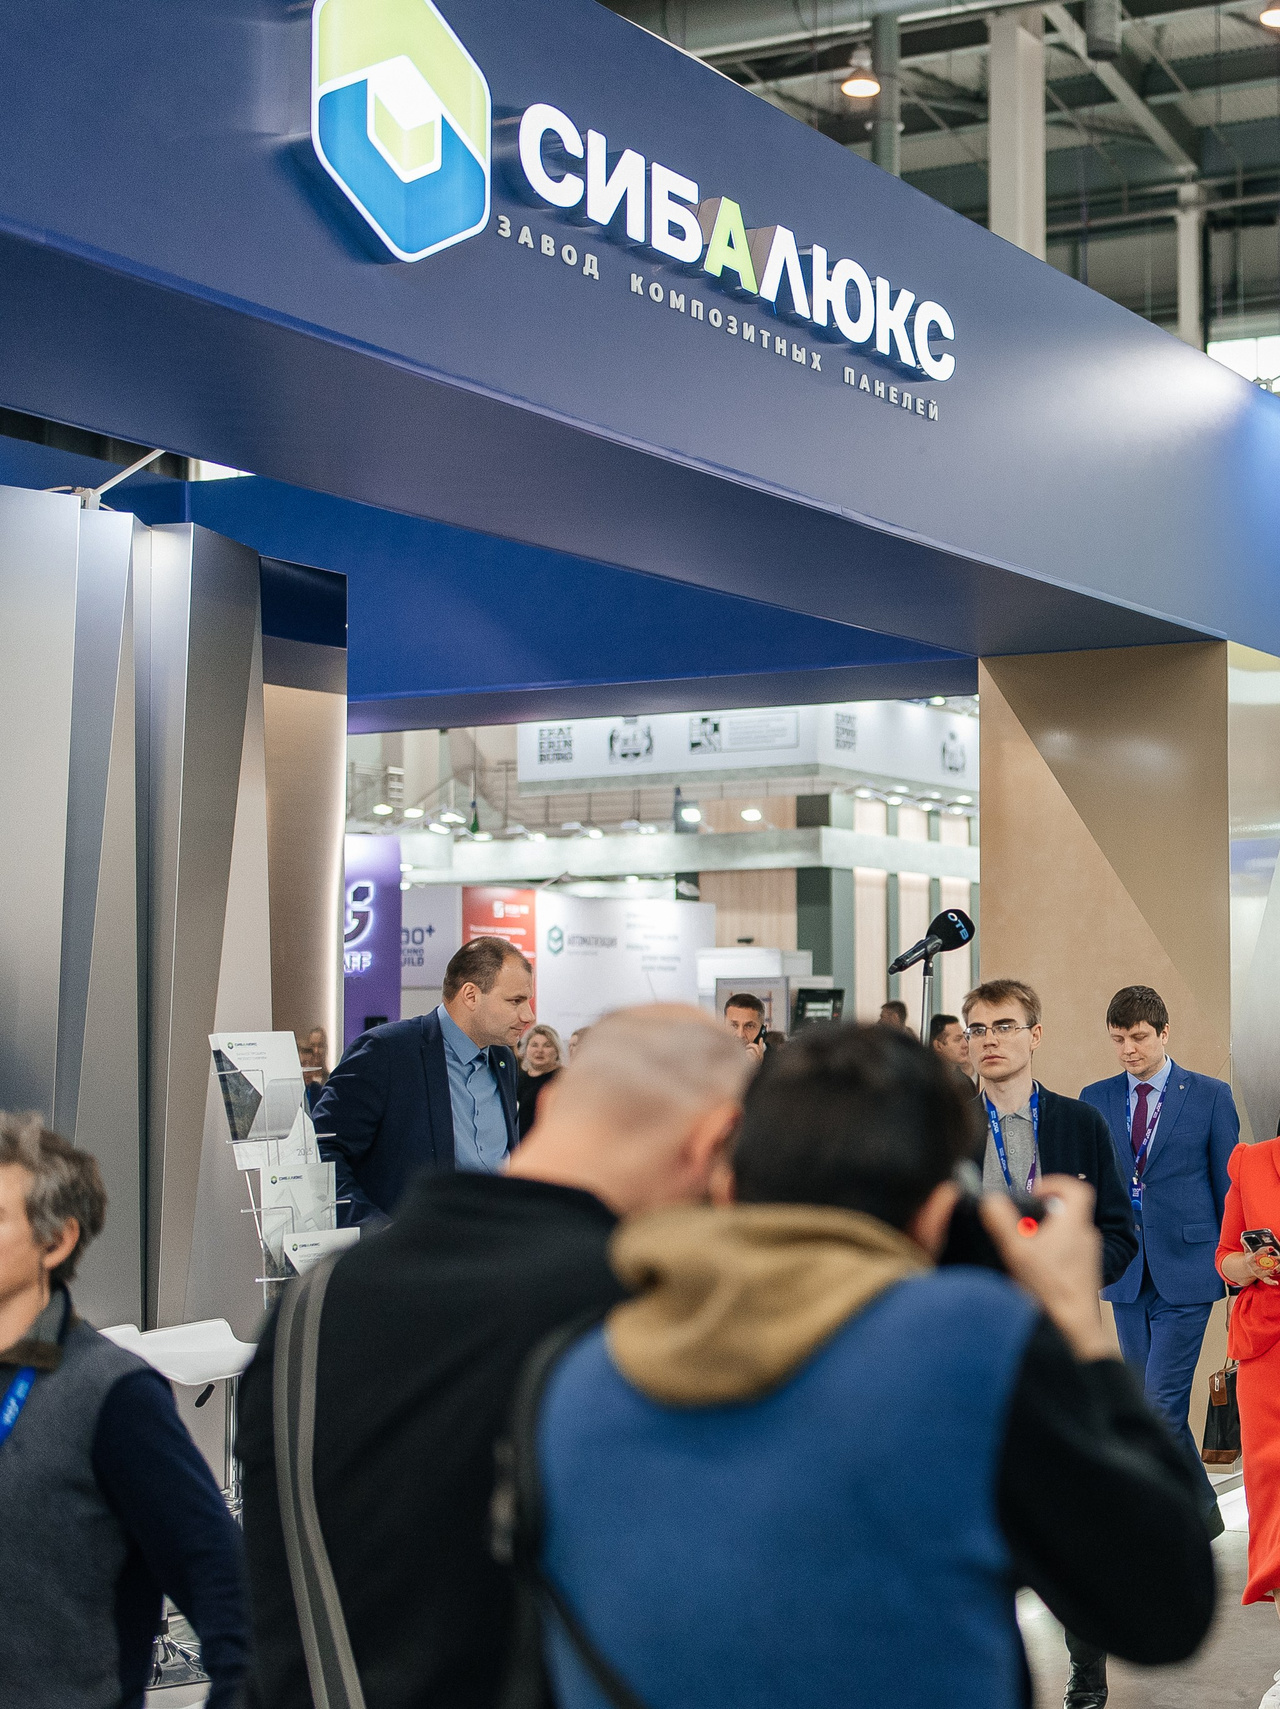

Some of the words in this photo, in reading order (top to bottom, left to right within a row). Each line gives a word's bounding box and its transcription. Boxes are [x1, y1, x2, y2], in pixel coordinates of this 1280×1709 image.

[497, 214, 600, 280] ЗАВОД
[630, 273, 823, 372] КОМПОЗИТНЫХ
[843, 366, 940, 421] ПАНЕЛЕЙ
[519, 103, 956, 381] СИБАЛЮКС
